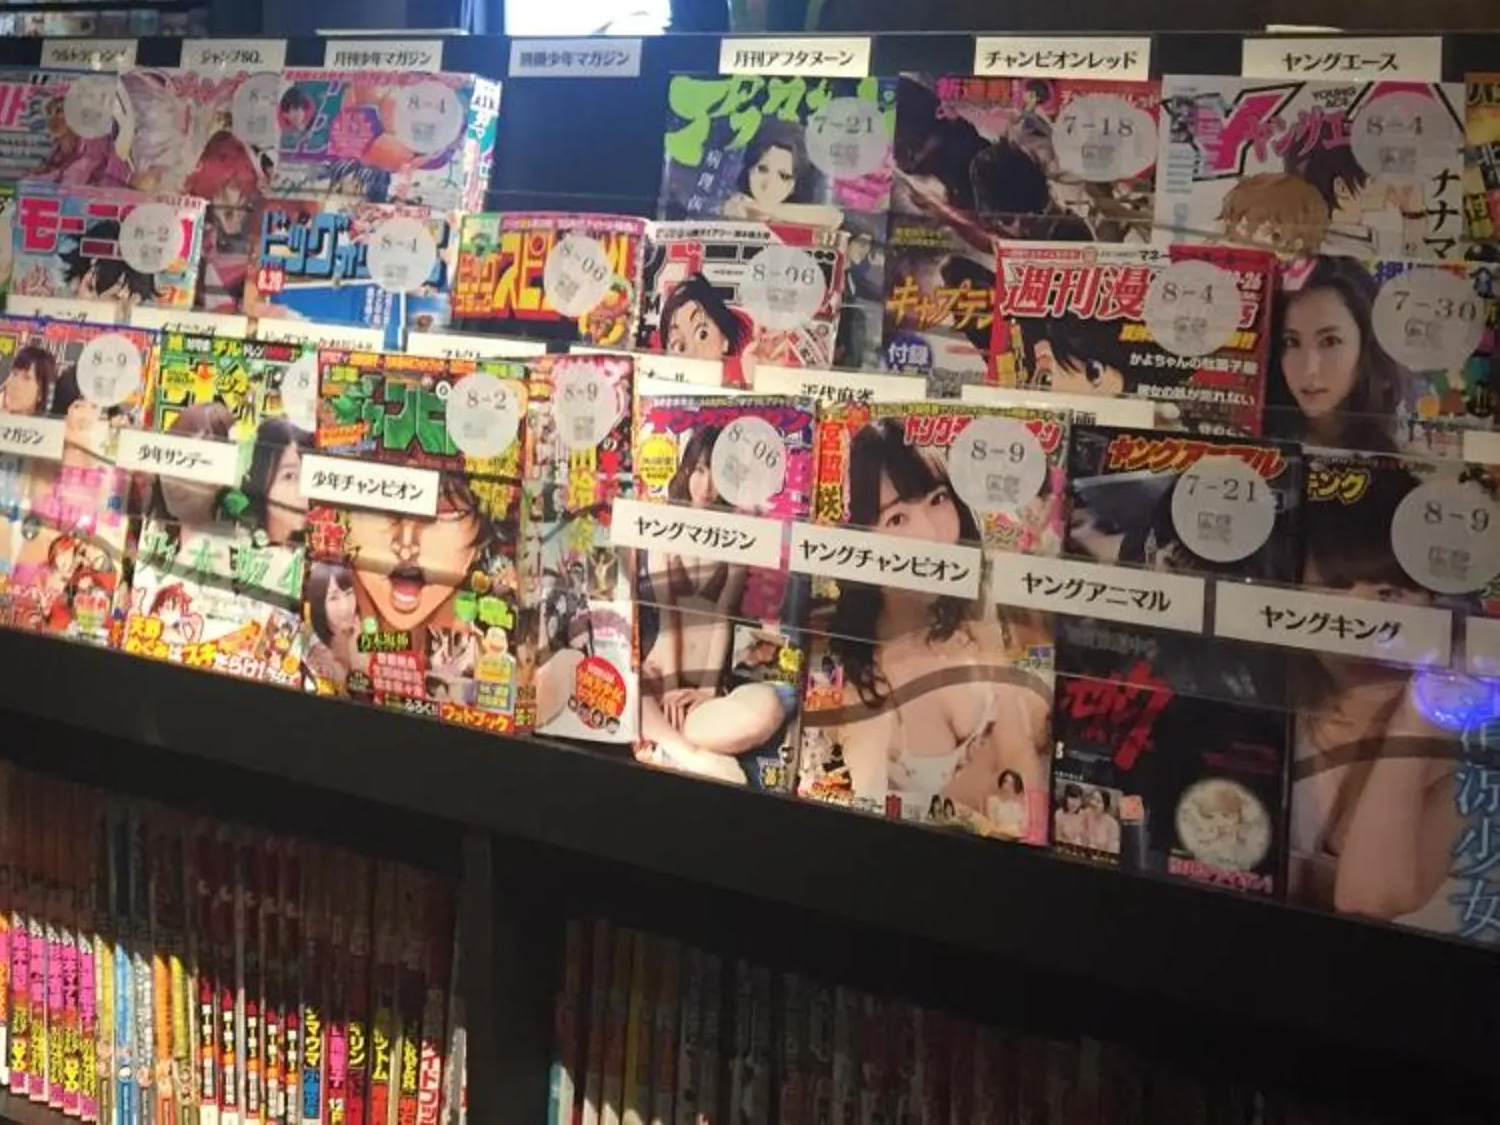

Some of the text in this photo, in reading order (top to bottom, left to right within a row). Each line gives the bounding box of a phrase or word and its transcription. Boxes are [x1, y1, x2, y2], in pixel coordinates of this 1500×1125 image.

[334, 51, 432, 67] 月刊少年マガジン
[734, 50, 854, 66] 月刊アフタヌーン
[984, 50, 1139, 71] チャンピオンレッド
[1283, 52, 1399, 72] ヤングエース
[1063, 116, 1135, 137] 7-18
[1366, 115, 1424, 137] 8-4
[1160, 283, 1215, 306] 8-4
[1392, 290, 1477, 322] 7-30
[466, 390, 509, 410] 8-2
[563, 380, 601, 402] 8-9
[137, 443, 215, 468] 少年サンデー
[726, 423, 783, 470] 8-06
[970, 438, 1026, 465] 8-9
[311, 471, 426, 501] 少年チャンピオン
[1186, 477, 1256, 504] 7-21
[1422, 501, 1491, 535] 8-9
[633, 515, 758, 551] ヤングマガジン
[798, 538, 971, 583] ヤングチャンピオン
[1020, 571, 1173, 614] ヤングアニマル
[1259, 604, 1401, 645] ヤングキング
